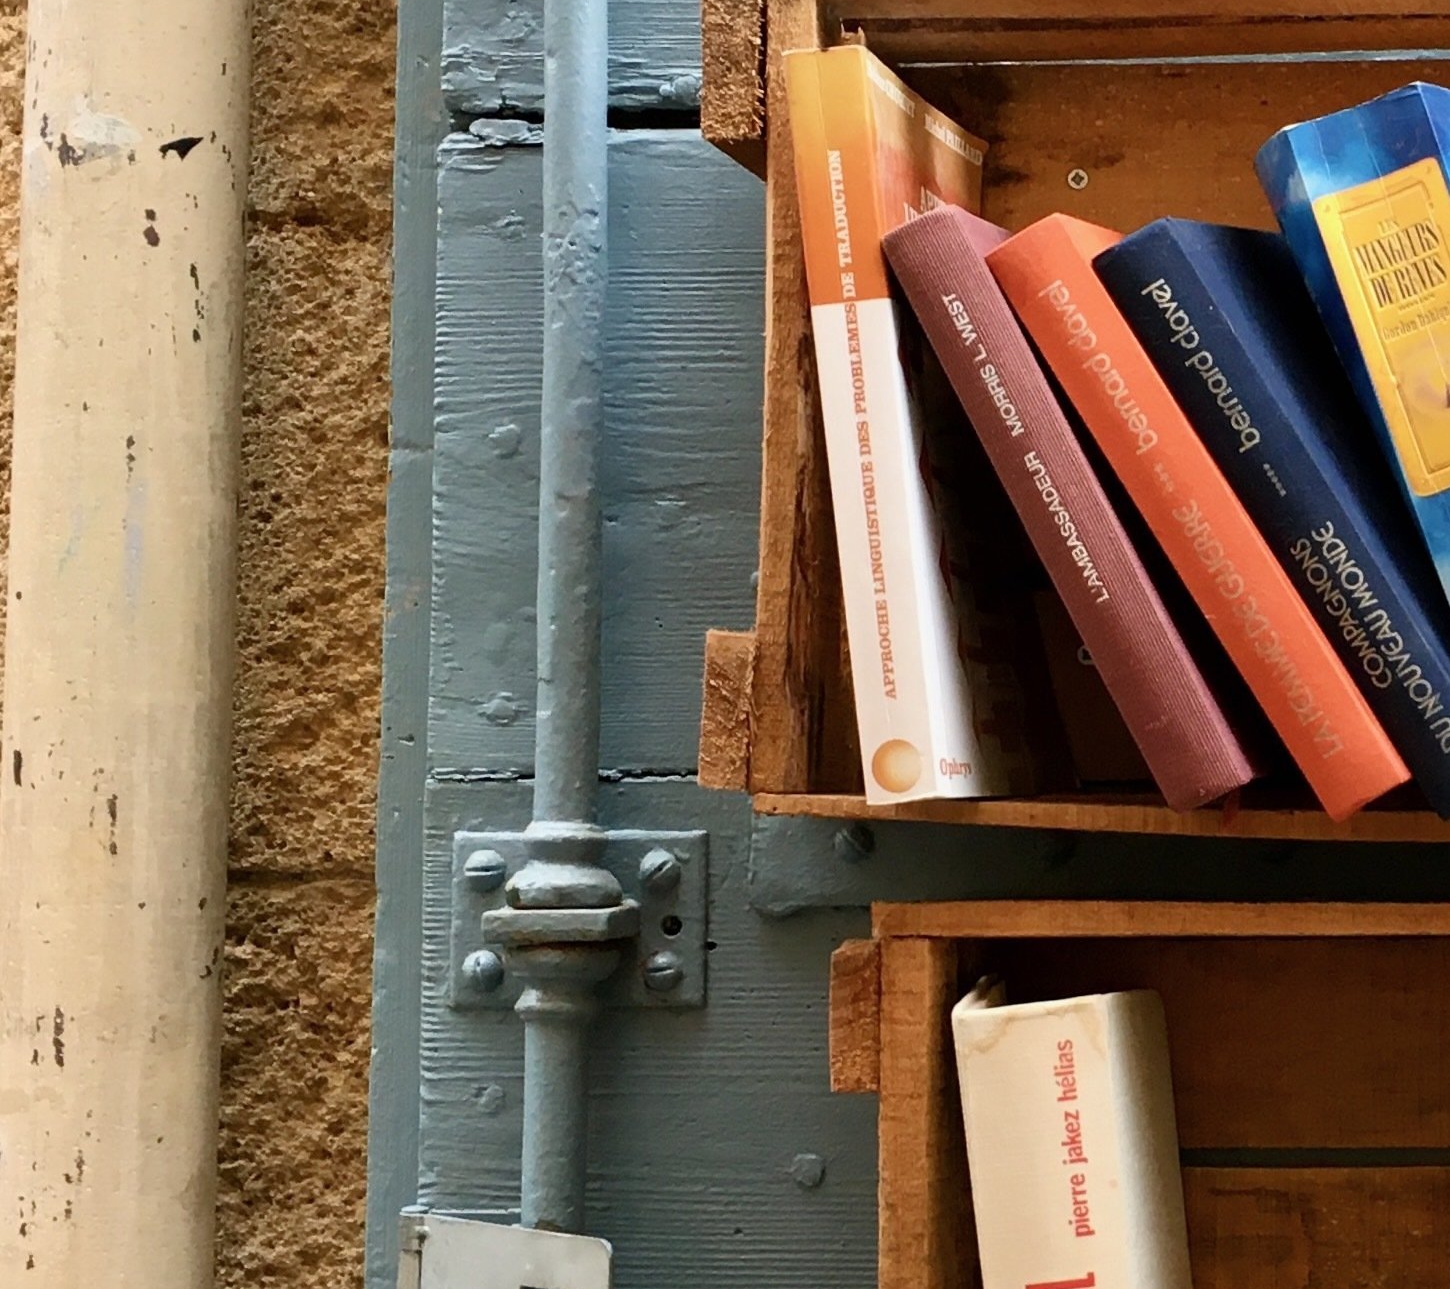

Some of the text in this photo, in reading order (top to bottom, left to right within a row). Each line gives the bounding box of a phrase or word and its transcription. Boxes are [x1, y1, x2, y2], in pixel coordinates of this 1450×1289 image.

[827, 150, 896, 700] APPROCHE LINGUISTIQUE DES PROBLEMES DE TRADUCTION
[942, 293, 1110, 604] L'AMBASSADEUR MORRIS WEST
[1038, 279, 1158, 455] bernard clavel
[1141, 278, 1261, 453] bernard clavel
[1290, 538, 1392, 690] COMPAGNONS
[1311, 520, 1379, 609] MONDE
[1364, 608, 1444, 720] NOUVEAU
[1054, 1039, 1095, 1238] pierre jakez hélias
